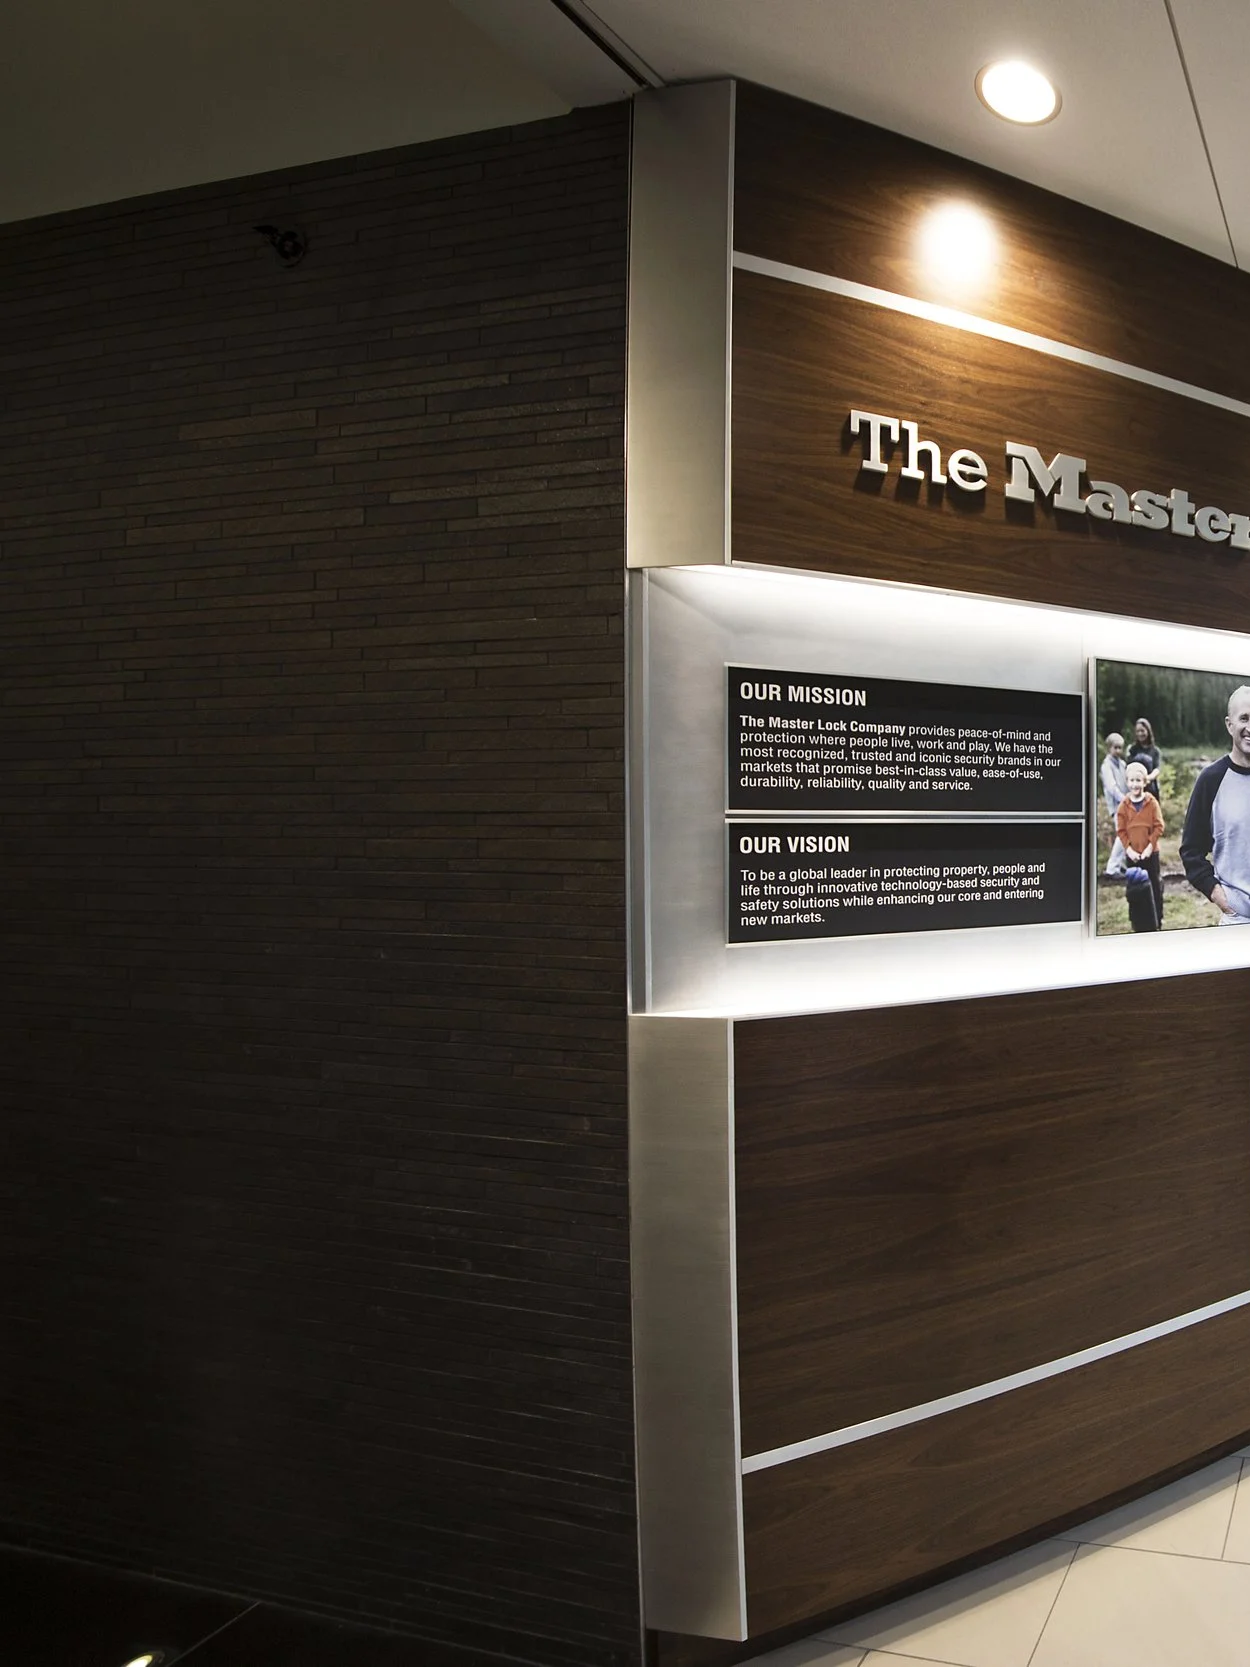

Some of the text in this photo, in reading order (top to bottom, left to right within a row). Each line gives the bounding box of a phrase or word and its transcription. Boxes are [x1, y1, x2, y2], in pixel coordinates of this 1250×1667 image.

[850, 409, 988, 492] The
[740, 682, 866, 706] OUR MISSION
[740, 715, 1051, 741] The Master Lock Company provides peace-of-mind and
[740, 732, 1053, 754] protection where people live, work and play. We have the
[740, 748, 1061, 767] most recognized, trusted and iconic security brands in our
[741, 762, 1043, 780] markets that promise best-in-class value, ease-of-use,
[740, 776, 973, 791] durability, reliability, quality and service.
[740, 836, 850, 854] OUR VISION
[741, 863, 1046, 882] To be a global leader in protecting property, people and
[741, 875, 1040, 896] life through innovative technology-based security and
[740, 889, 1044, 912] safety solutions while enhancing our core and entering
[741, 912, 825, 926] new markets.
